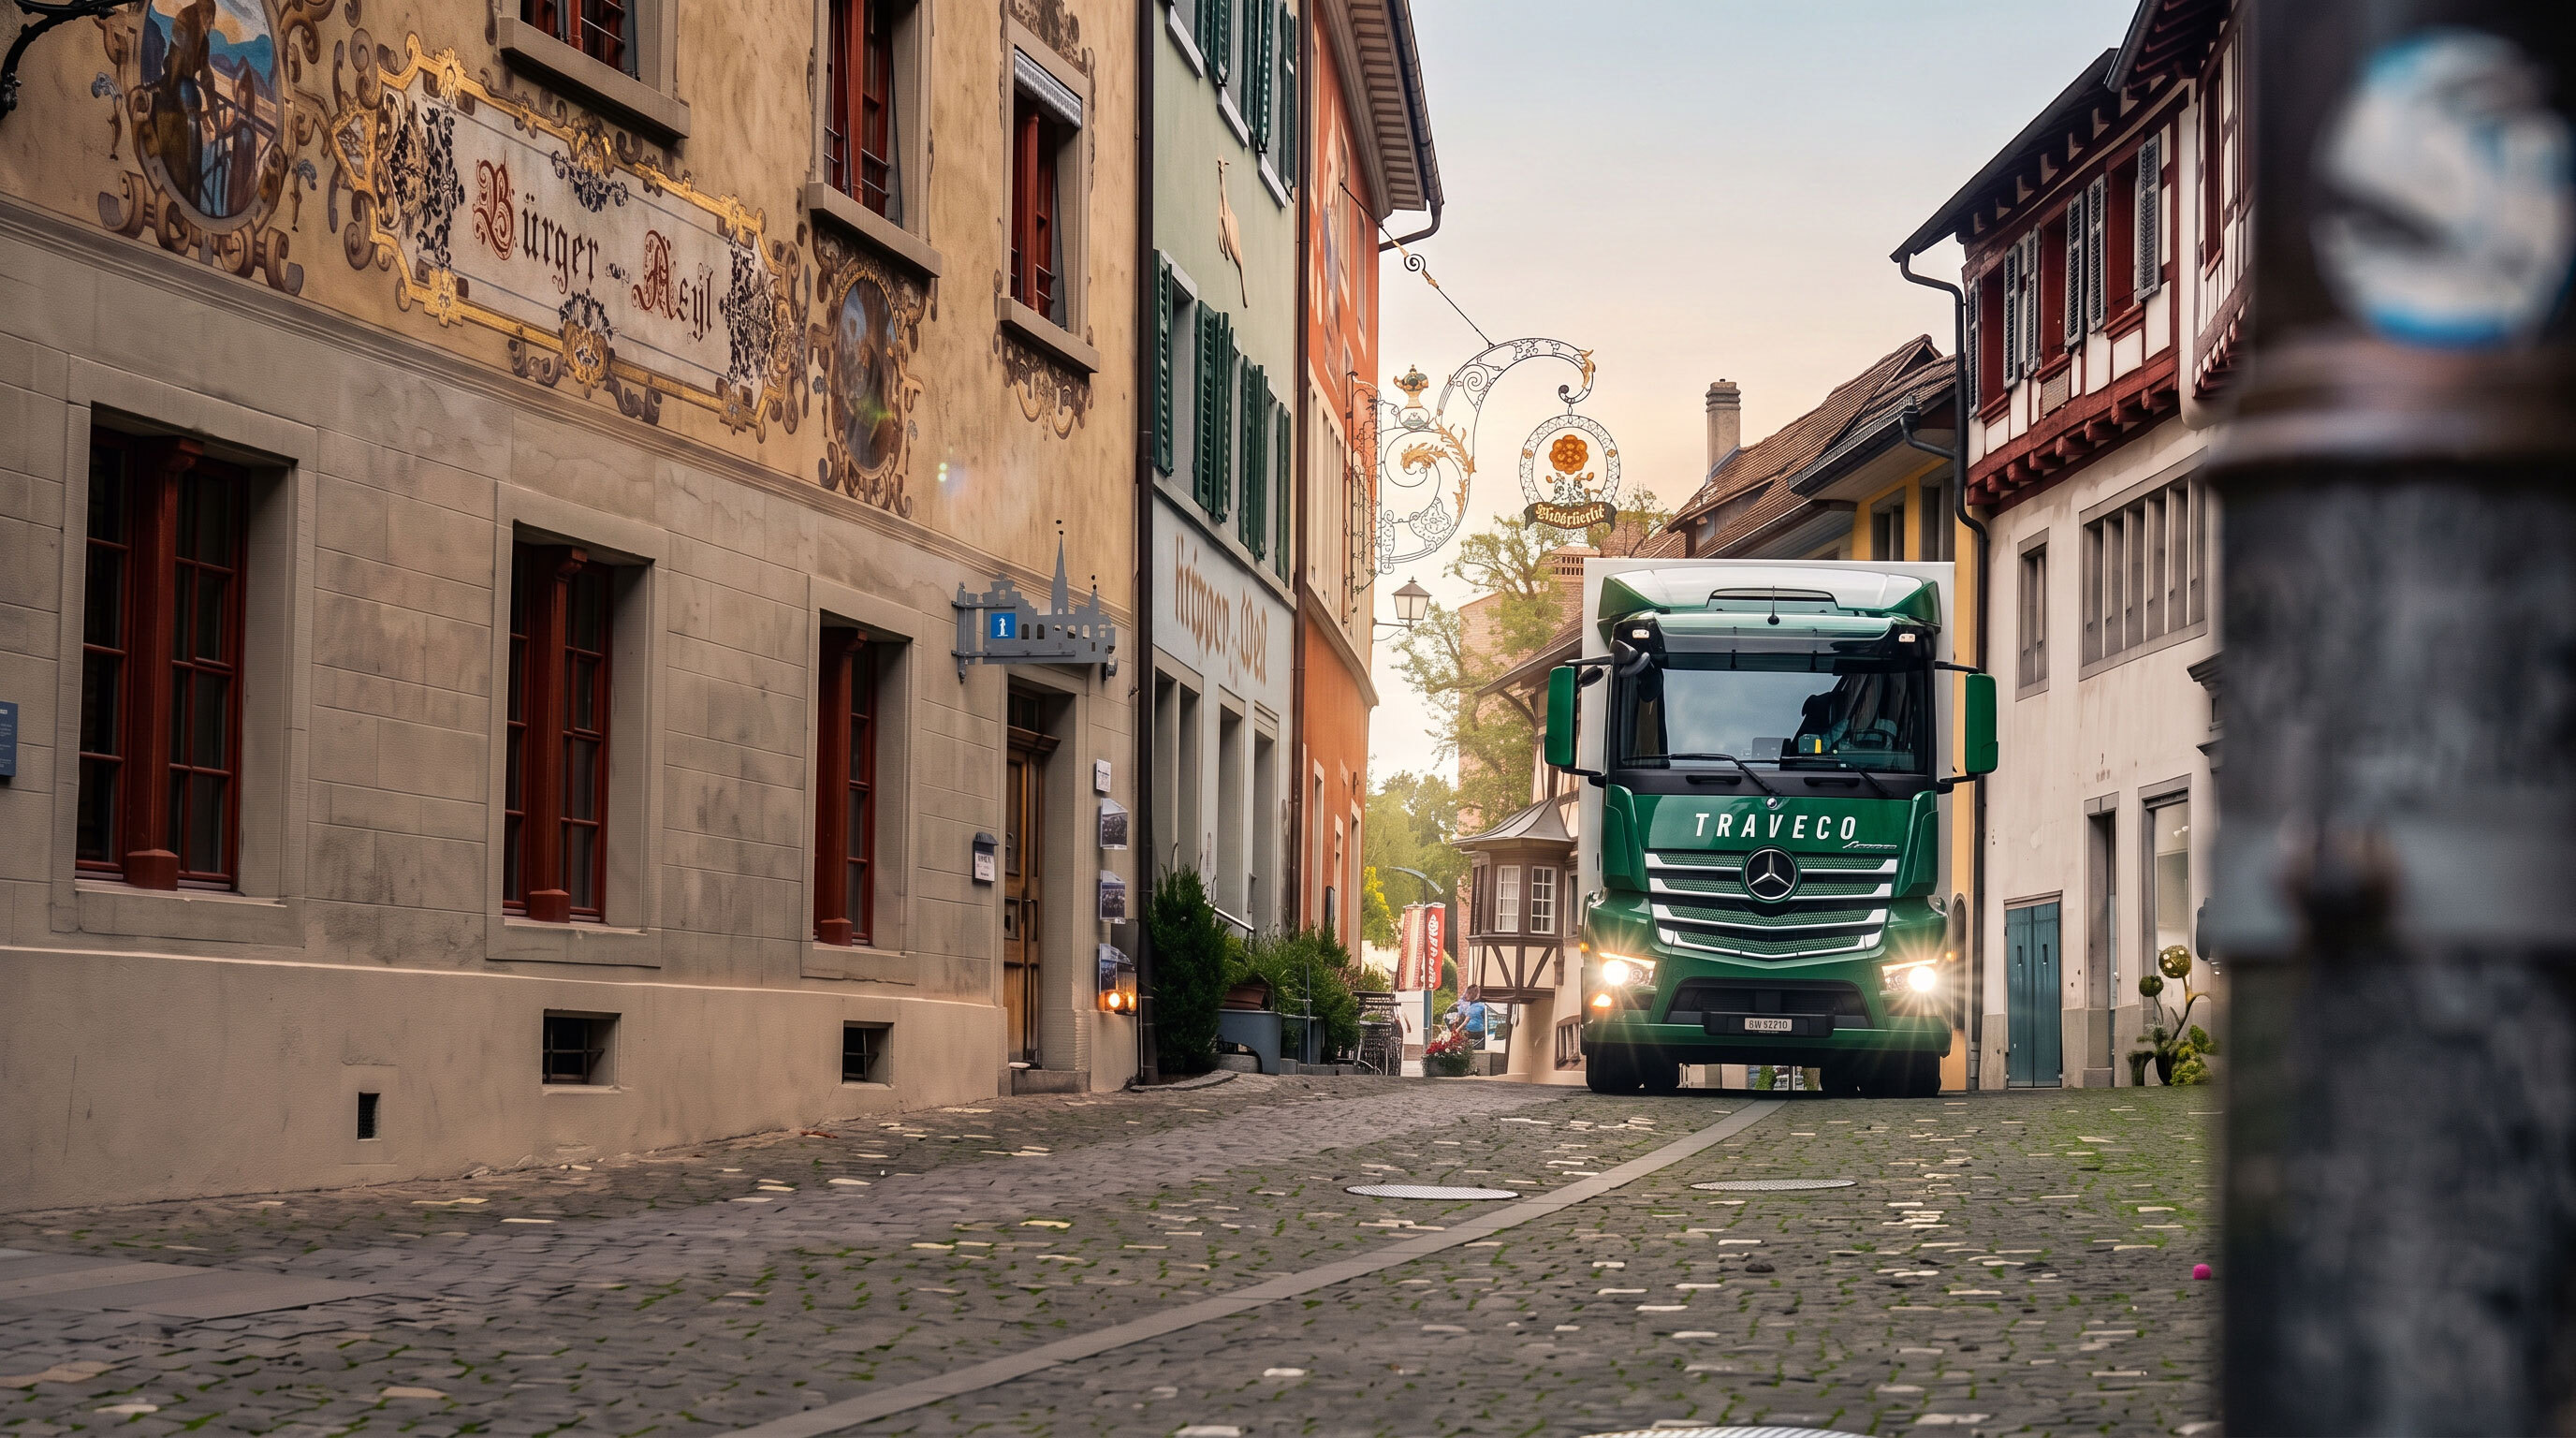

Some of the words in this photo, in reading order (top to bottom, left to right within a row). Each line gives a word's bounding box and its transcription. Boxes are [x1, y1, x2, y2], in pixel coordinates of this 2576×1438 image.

[472, 149, 599, 295] Bürger
[631, 229, 714, 344] Asyl
[1695, 813, 1856, 841] TRAVECO
